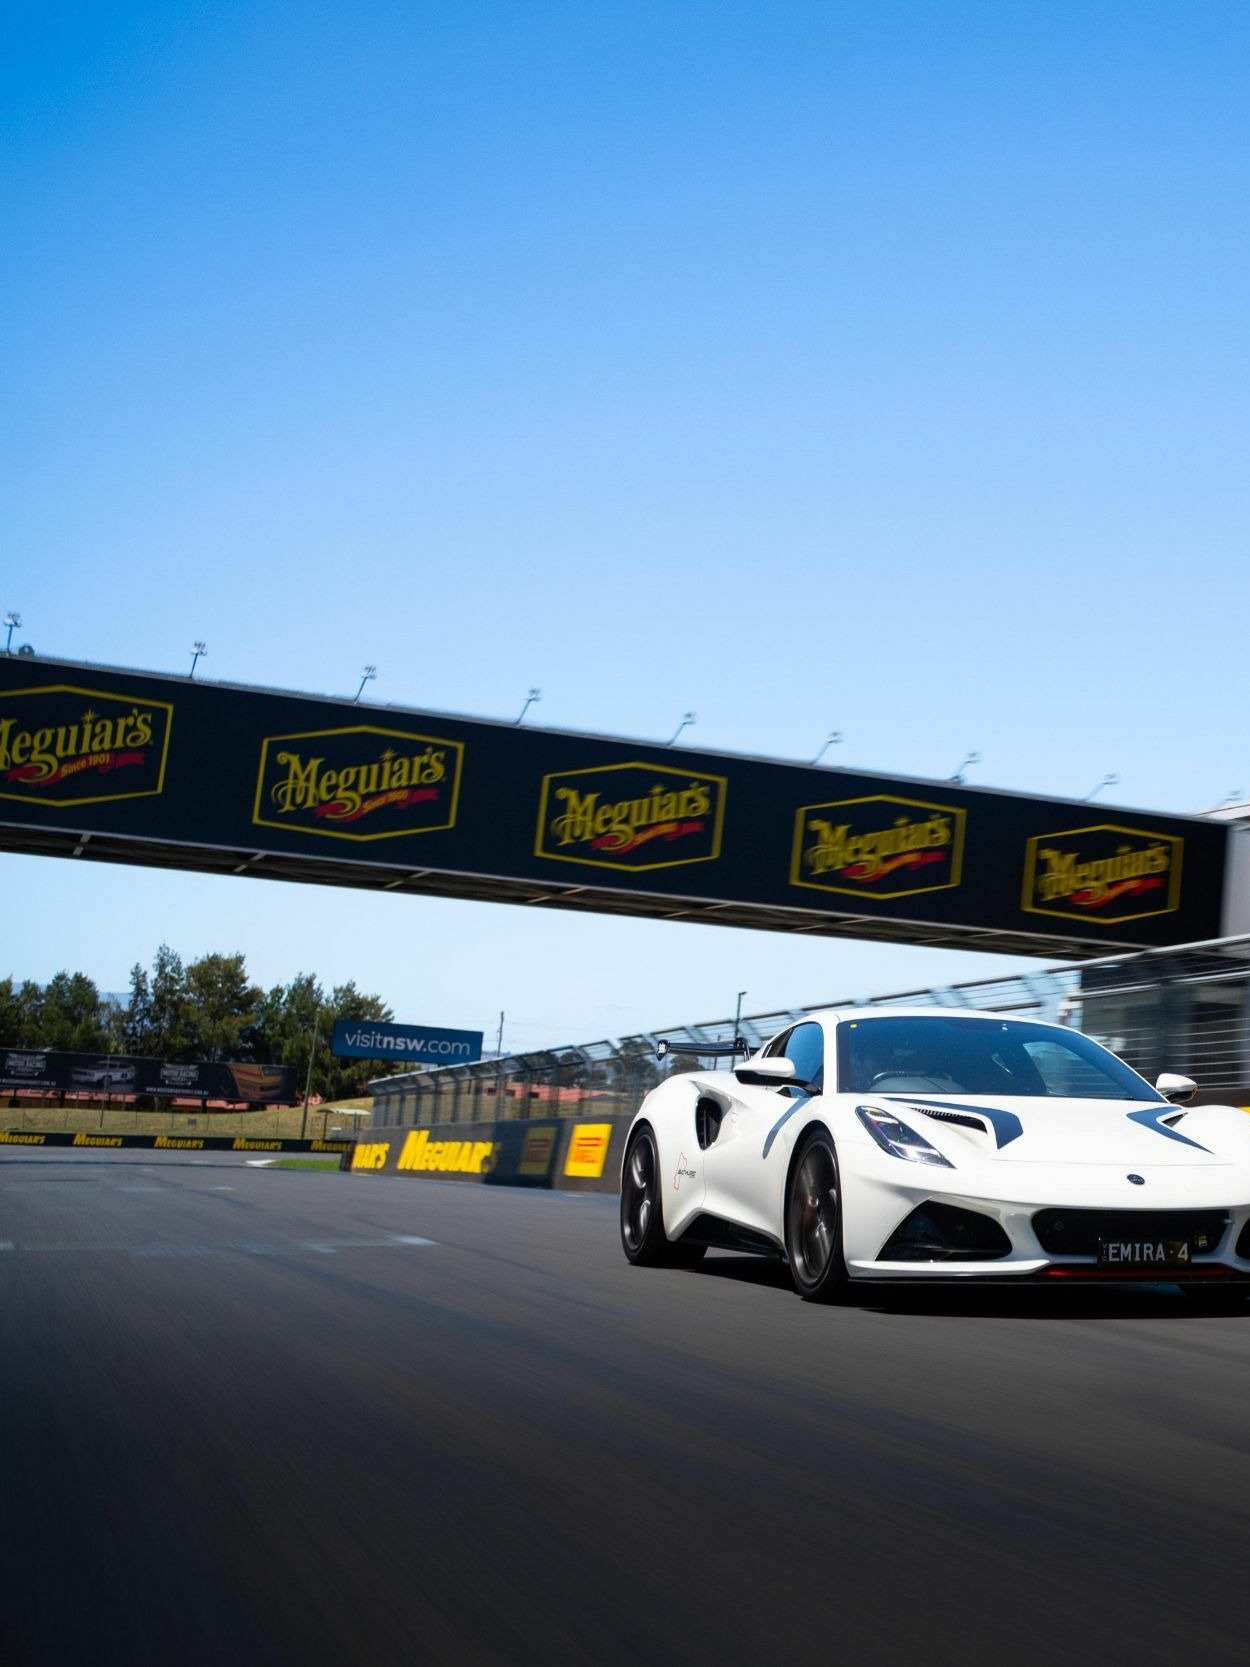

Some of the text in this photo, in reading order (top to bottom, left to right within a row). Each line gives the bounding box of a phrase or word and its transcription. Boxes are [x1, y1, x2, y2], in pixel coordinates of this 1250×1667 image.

[271, 746, 446, 819] Meguiar's
[552, 781, 711, 850] Meguiar's
[344, 1029, 471, 1056] visitnsw.com
[1108, 1242, 1188, 1262] EMIRA 4
